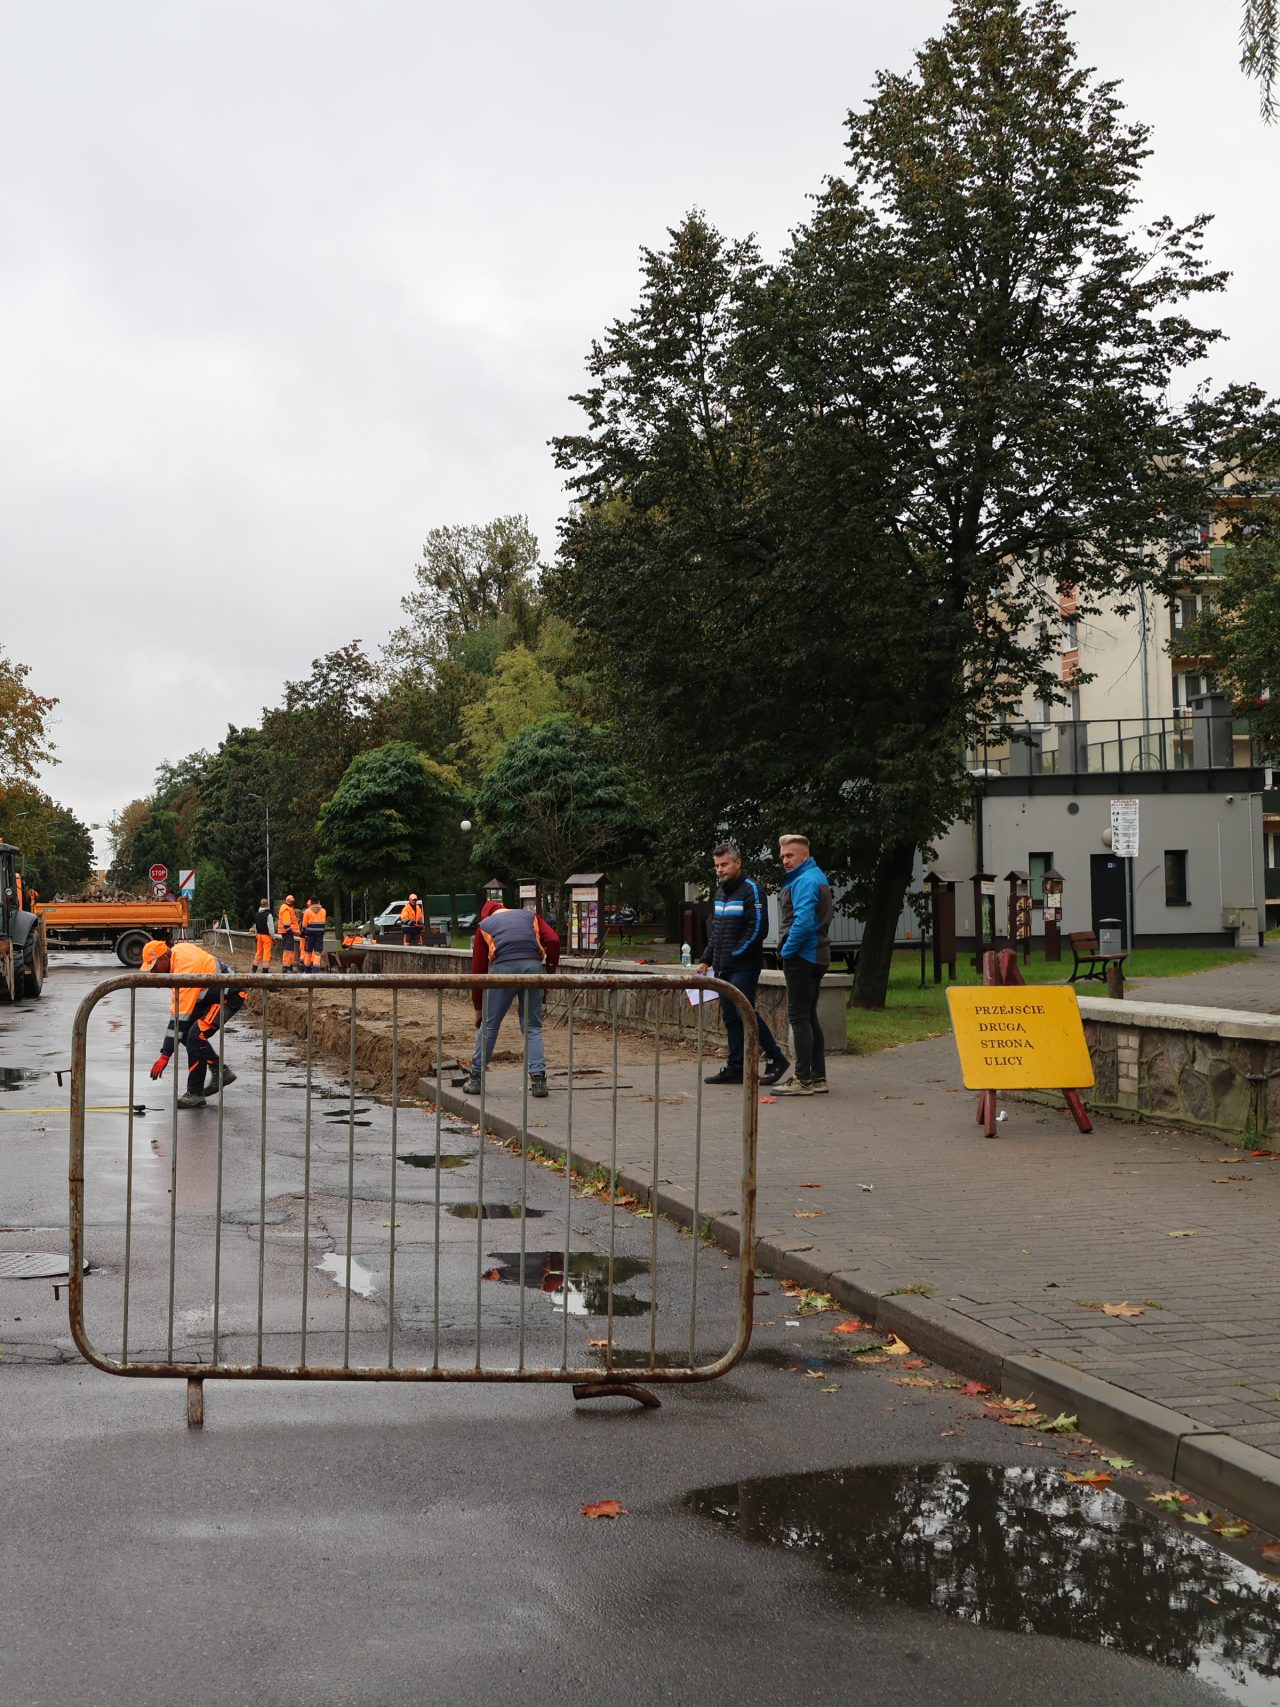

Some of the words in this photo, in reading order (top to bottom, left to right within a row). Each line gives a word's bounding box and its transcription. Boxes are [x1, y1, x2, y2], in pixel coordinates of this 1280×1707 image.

[979, 1022, 1027, 1034] DRUGĄ
[980, 1039, 1035, 1050] STRONĄ
[984, 1056, 1024, 1066] ULICY
